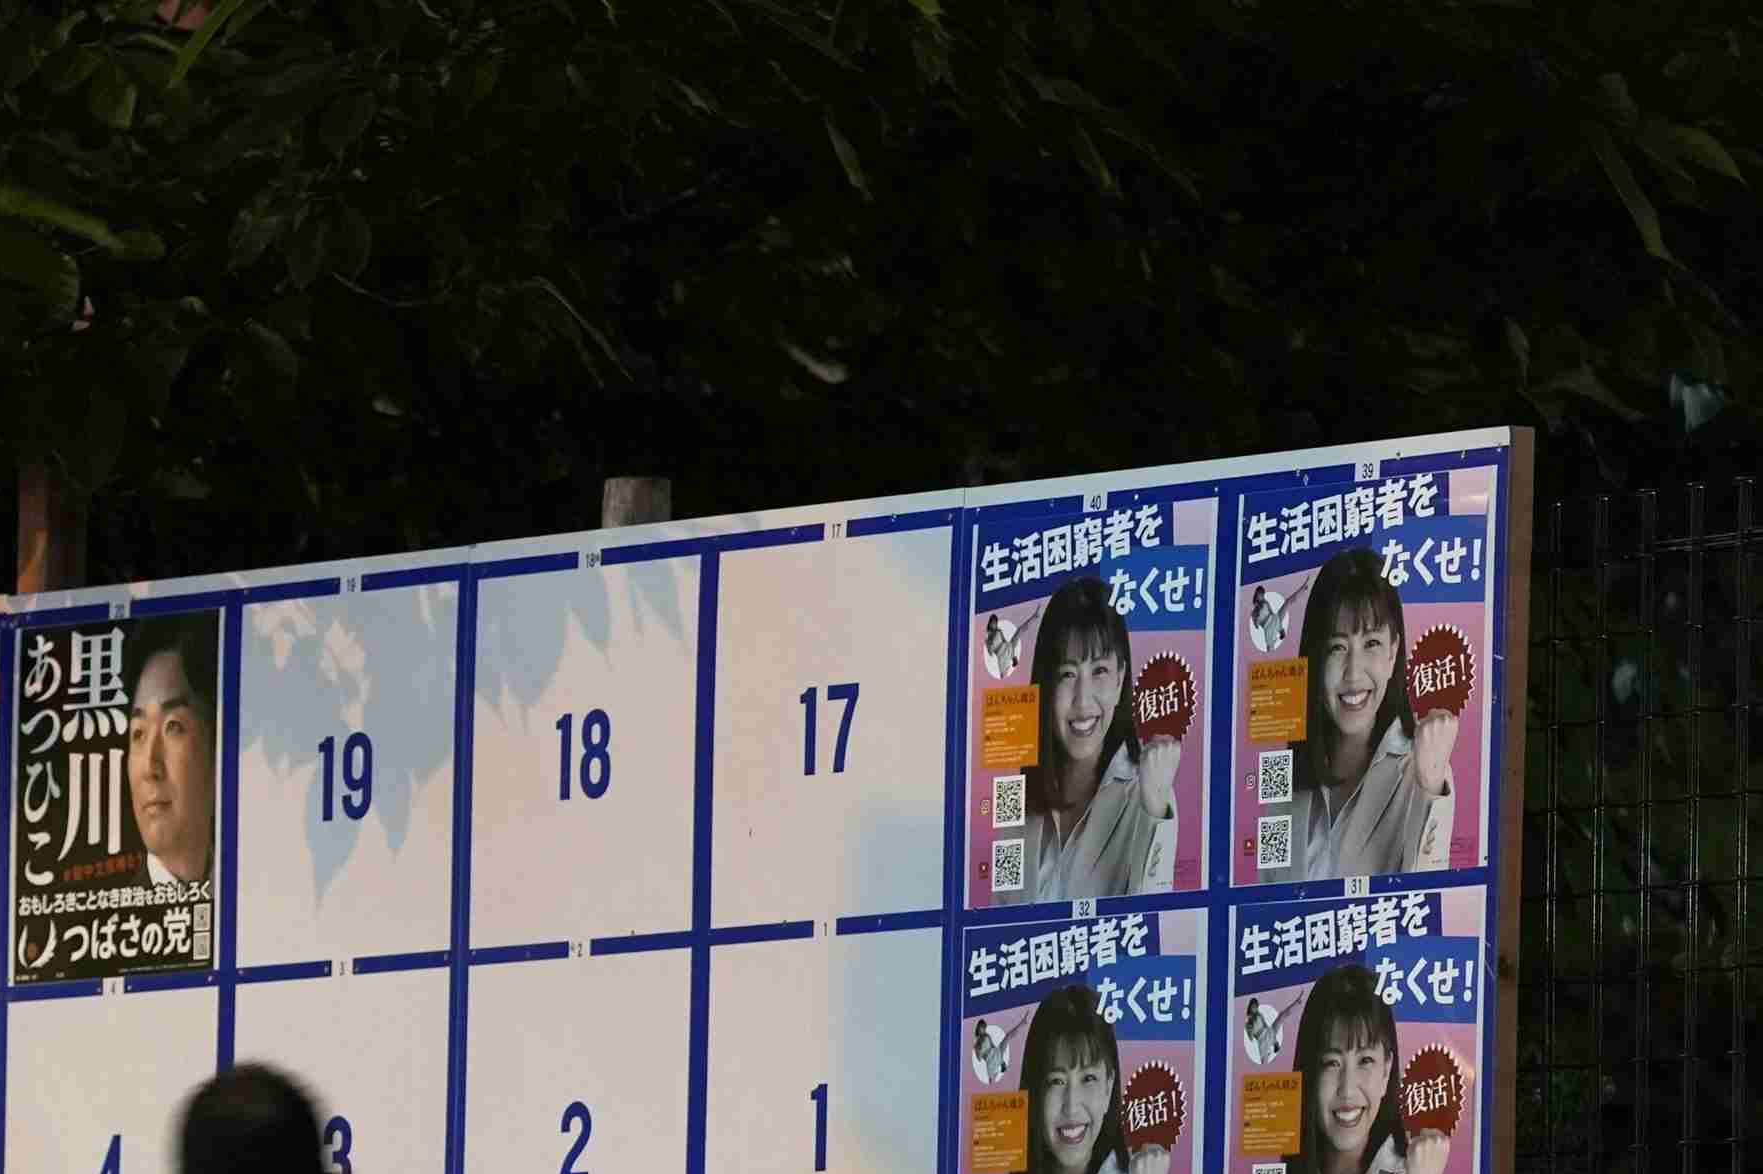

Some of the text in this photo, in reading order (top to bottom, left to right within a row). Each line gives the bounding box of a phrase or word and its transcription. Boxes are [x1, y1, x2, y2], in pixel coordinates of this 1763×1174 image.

[979, 504, 1163, 592] 生活困窮者を
[1246, 473, 1438, 564] 生活困窮者を
[1107, 566, 1204, 615] なくせ!
[1379, 537, 1482, 587] なくせ!
[1138, 682, 1192, 724] 復活!
[1412, 654, 1469, 698] 復活!
[21, 634, 63, 887] あつひこ
[56, 627, 131, 862] 黒川
[555, 708, 612, 801] 18
[799, 682, 860, 776] 17
[318, 731, 374, 823] 19
[62, 906, 192, 963] つばさの党
[967, 913, 1149, 997] 生活困窮者を
[1238, 892, 1431, 975] 生活困窮者を
[1095, 976, 1191, 1024] なくせ!
[1373, 957, 1474, 1005] なくせ!
[809, 1083, 829, 1172] 1
[1126, 1089, 1180, 1132] 復活!
[1404, 1074, 1458, 1117] 復活!
